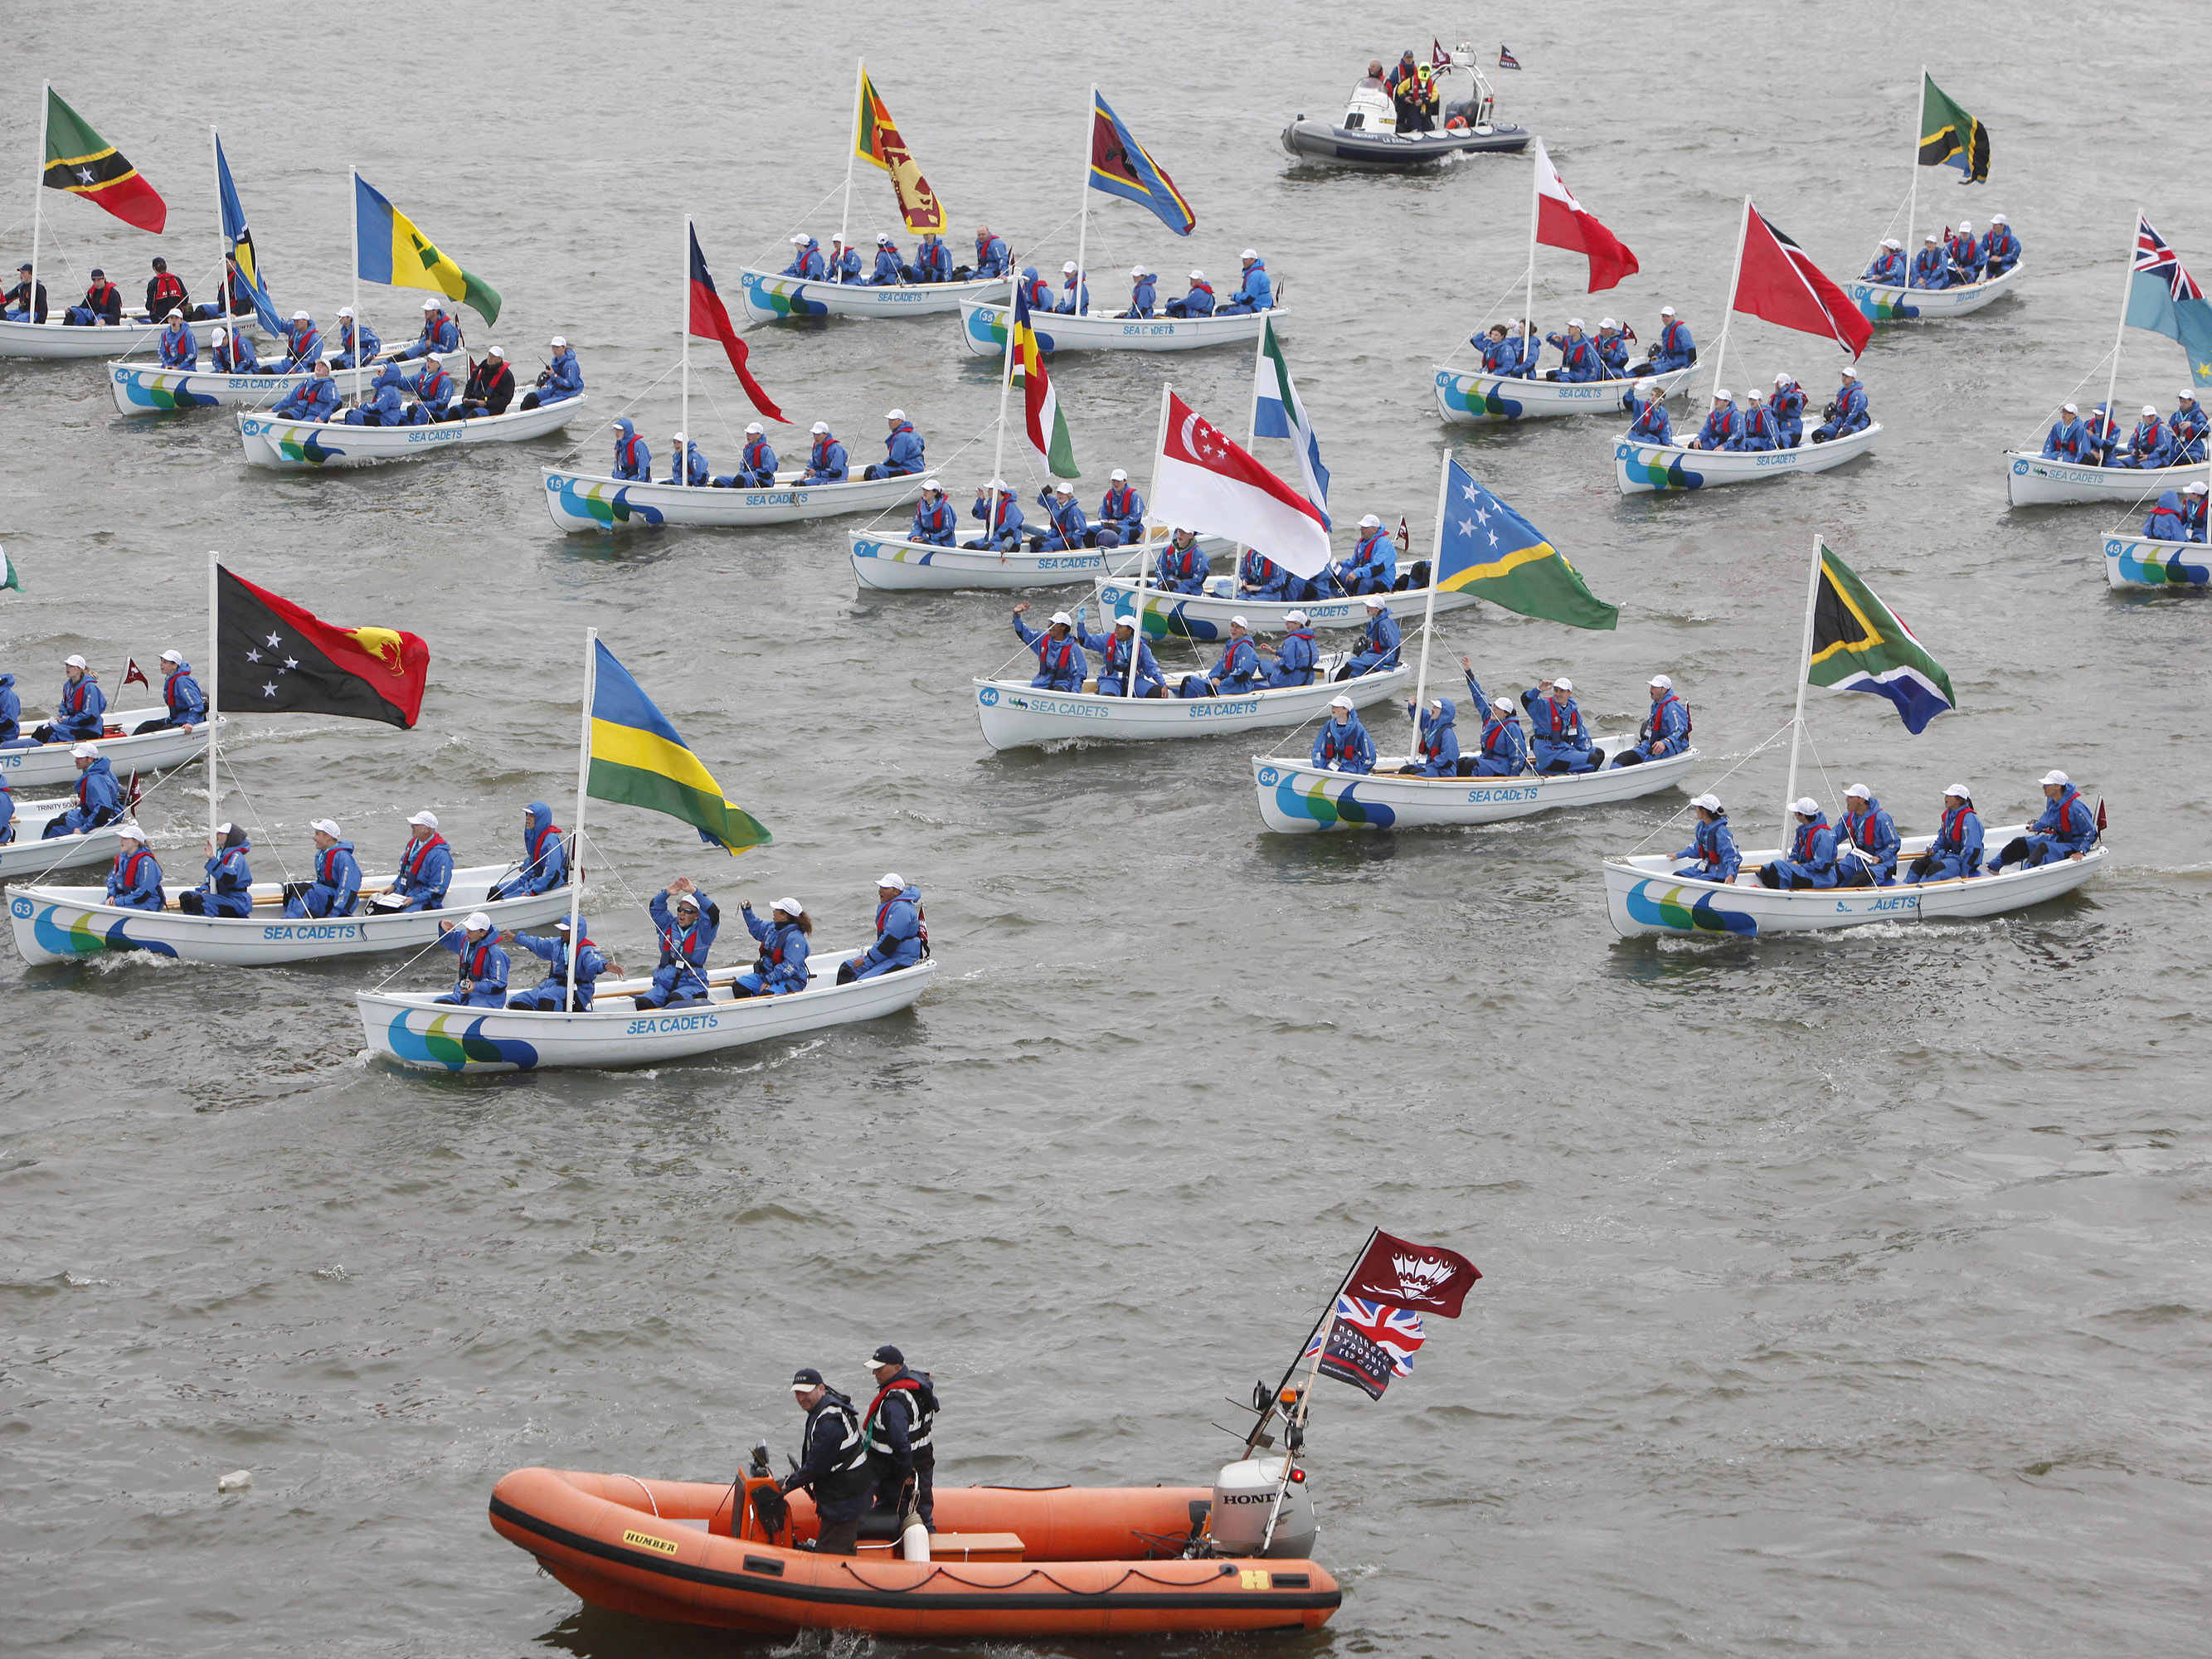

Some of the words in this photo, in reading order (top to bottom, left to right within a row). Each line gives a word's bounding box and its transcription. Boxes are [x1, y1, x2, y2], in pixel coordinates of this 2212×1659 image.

[742, 276, 754, 285] 55
[878, 292, 893, 302] SEA
[894, 293, 922, 302] CADETS
[1856, 289, 1866, 297] 17
[981, 313, 994, 322] 35
[1123, 326, 1140, 336] SEA
[117, 372, 129, 381] 54
[1437, 375, 1449, 385] 16
[228, 378, 249, 389] SEA
[250, 377, 289, 389] CADETS
[1558, 389, 1573, 398] SEA
[245, 423, 258, 432] 34
[408, 432, 426, 442] SEA
[427, 430, 463, 441] CADETS
[1620, 448, 1627, 457] 8
[1757, 456, 1770, 466] SEA
[1771, 454, 1796, 465] CADETS
[2015, 463, 2026, 472] 26
[2048, 469, 2068, 480] SEA
[2069, 472, 2104, 484] CADETS
[548, 479, 562, 489] 15
[746, 496, 766, 507] SEA
[859, 544, 867, 553] 7
[2107, 543, 2120, 554] 45
[1038, 559, 1059, 569] SEA
[1061, 557, 1101, 568] CADETS
[1102, 591, 1117, 601] 25
[1309, 606, 1349, 618] CADETS
[980, 691, 998, 703] 44
[1030, 700, 1057, 713] SEA
[1058, 704, 1109, 718] CADETS
[1189, 706, 1212, 718] SEA
[1213, 703, 1257, 716] CADETS
[1261, 771, 1276, 783] 64
[1468, 791, 1491, 803] SEA
[36, 803, 63, 812] TRINITY
[14, 902, 32, 915] 63
[263, 927, 293, 940] SEA
[296, 925, 356, 940] CADETS
[626, 1020, 657, 1034] SEA
[659, 1014, 718, 1033] CADETS
[1339, 1324, 1389, 1362] northern
[1333, 1334, 1387, 1372] exposure
[1339, 1347, 1379, 1376] rescue
[625, 1532, 675, 1552] HUMBER
